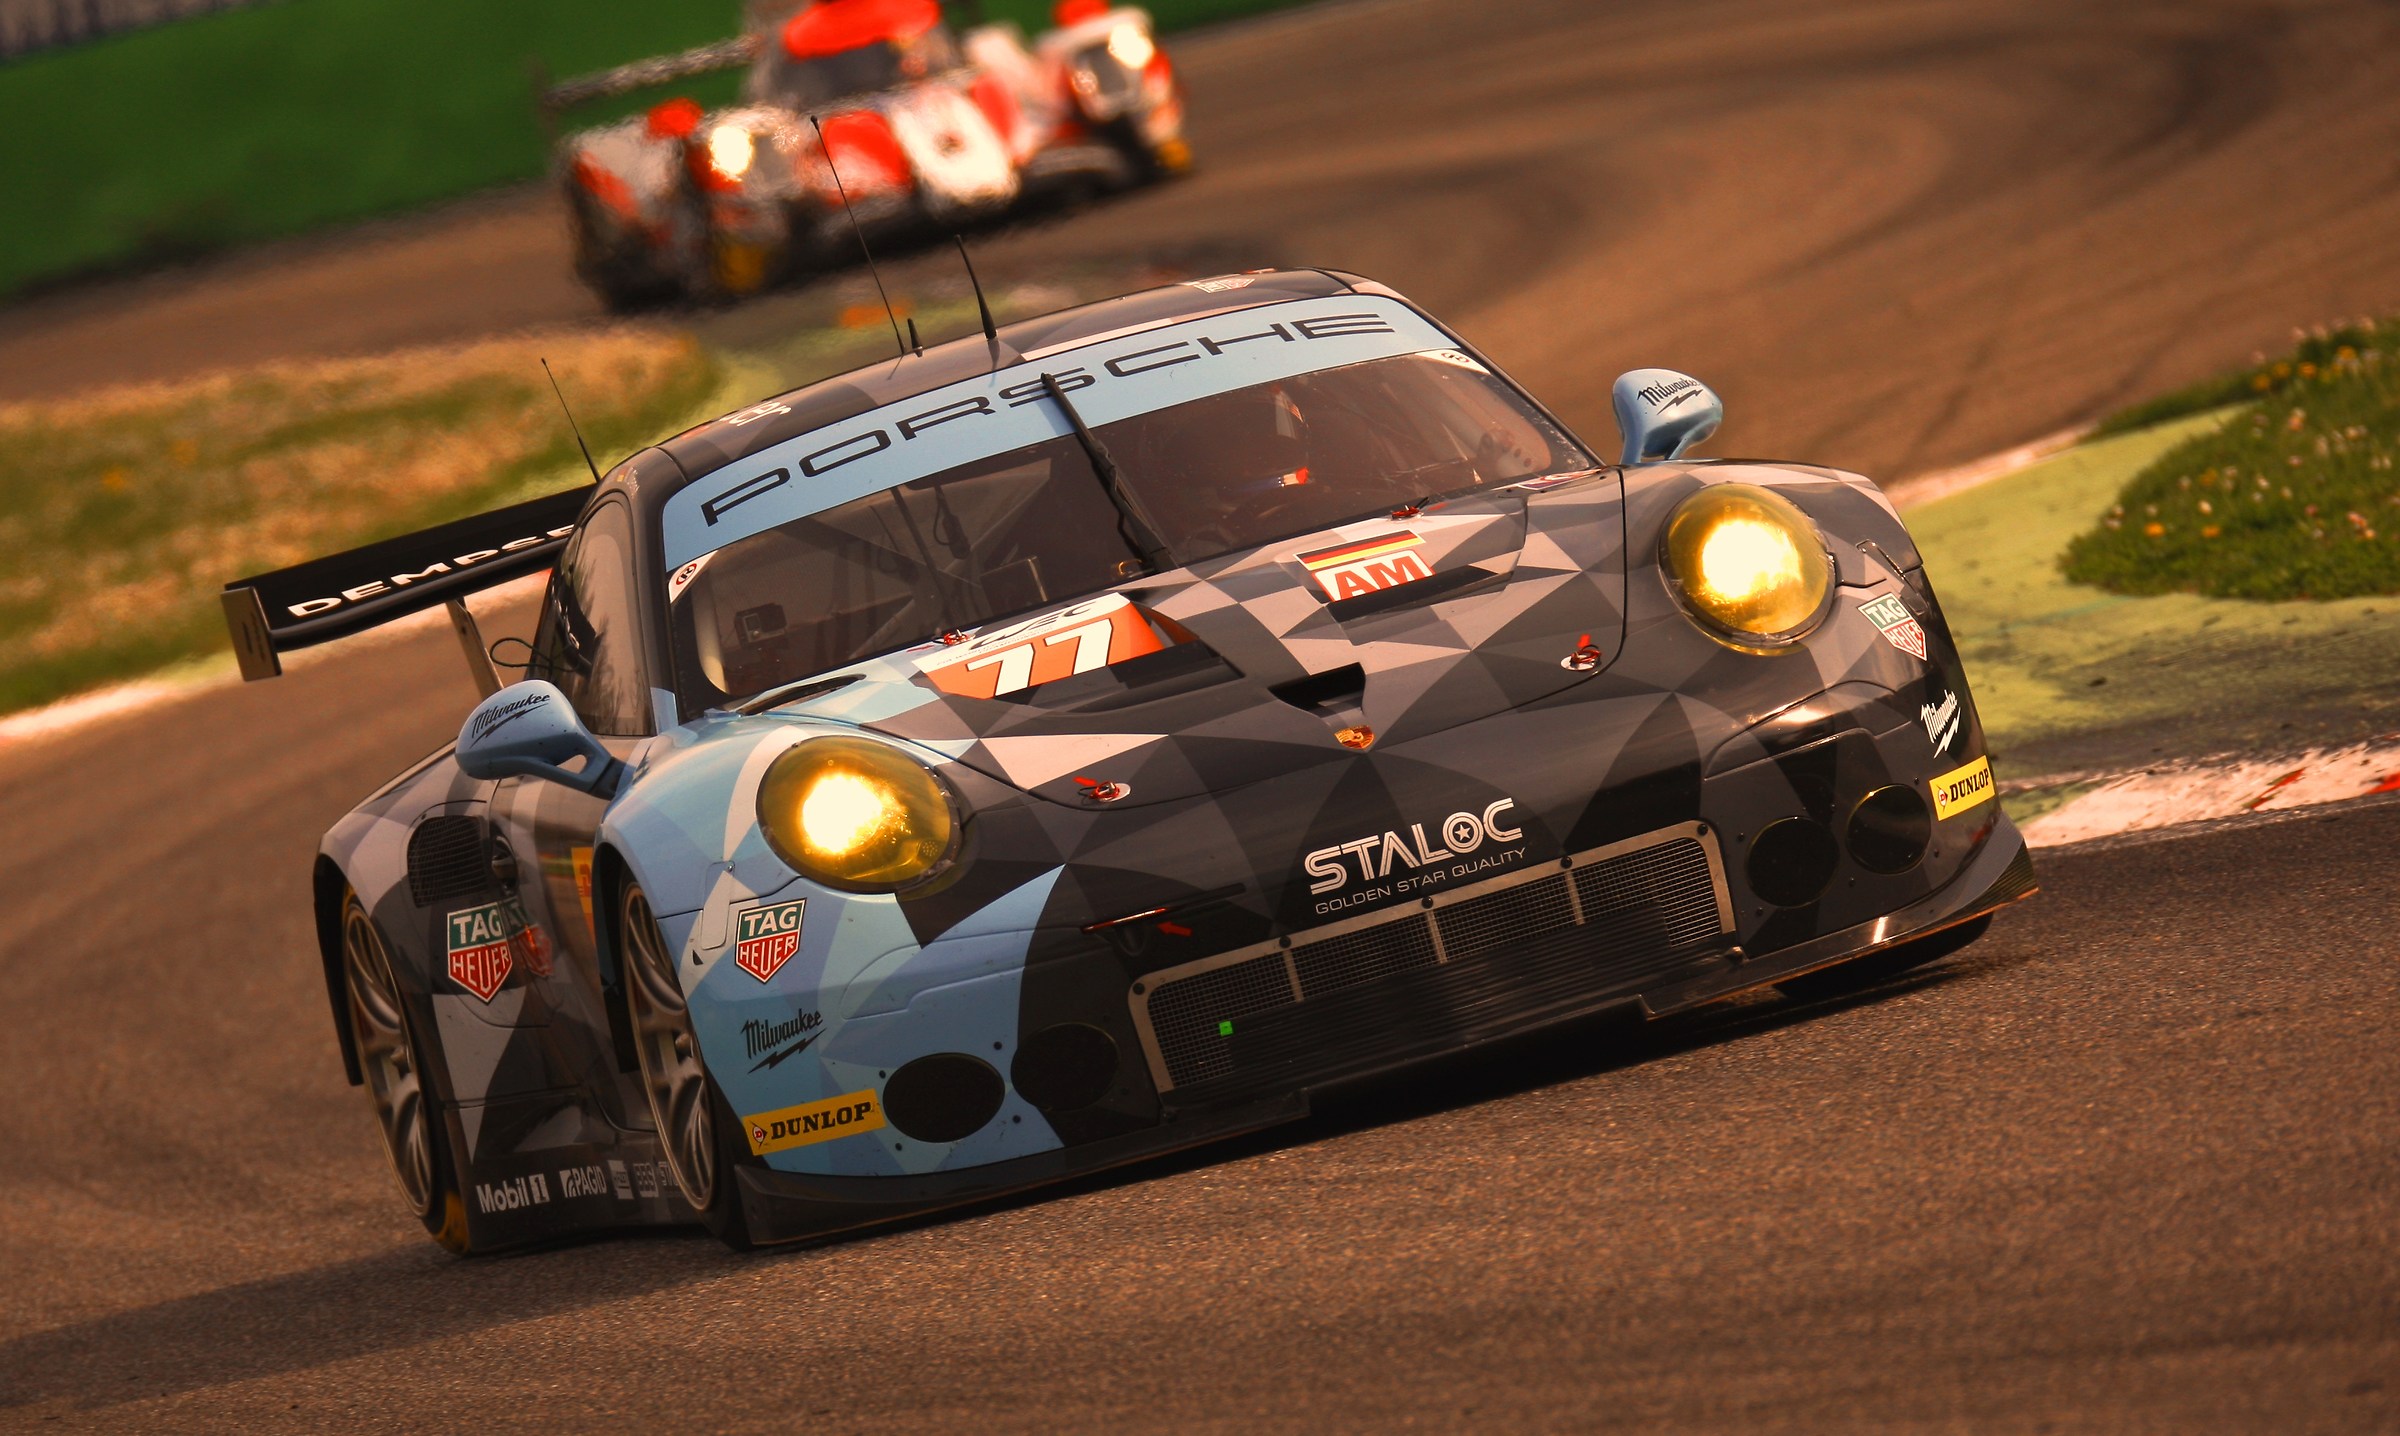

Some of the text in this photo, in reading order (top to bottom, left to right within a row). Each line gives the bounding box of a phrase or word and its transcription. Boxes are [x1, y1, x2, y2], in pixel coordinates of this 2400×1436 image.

[1636, 378, 1699, 406] Milwaukee
[700, 313, 1395, 527] PORSCHE
[1335, 556, 1424, 601] AM
[1865, 598, 1907, 626] TAG
[965, 617, 1114, 698] 77
[1886, 621, 1923, 655] HEUER
[472, 693, 550, 739] Milwaukee
[1949, 767, 1990, 803] DUNLOP
[1304, 797, 1523, 895] STALOC
[1315, 847, 1526, 915] GOLDEN STAR QUALITY
[453, 908, 503, 945] TAG
[744, 906, 798, 938] TAG
[452, 945, 510, 994] HEUER
[739, 934, 796, 976] HEUER
[740, 1008, 823, 1060] Milwaukee
[770, 1101, 872, 1140] DUNLOP
[475, 1175, 549, 1214] Mobil 1
[572, 1165, 608, 1198] PAGID
